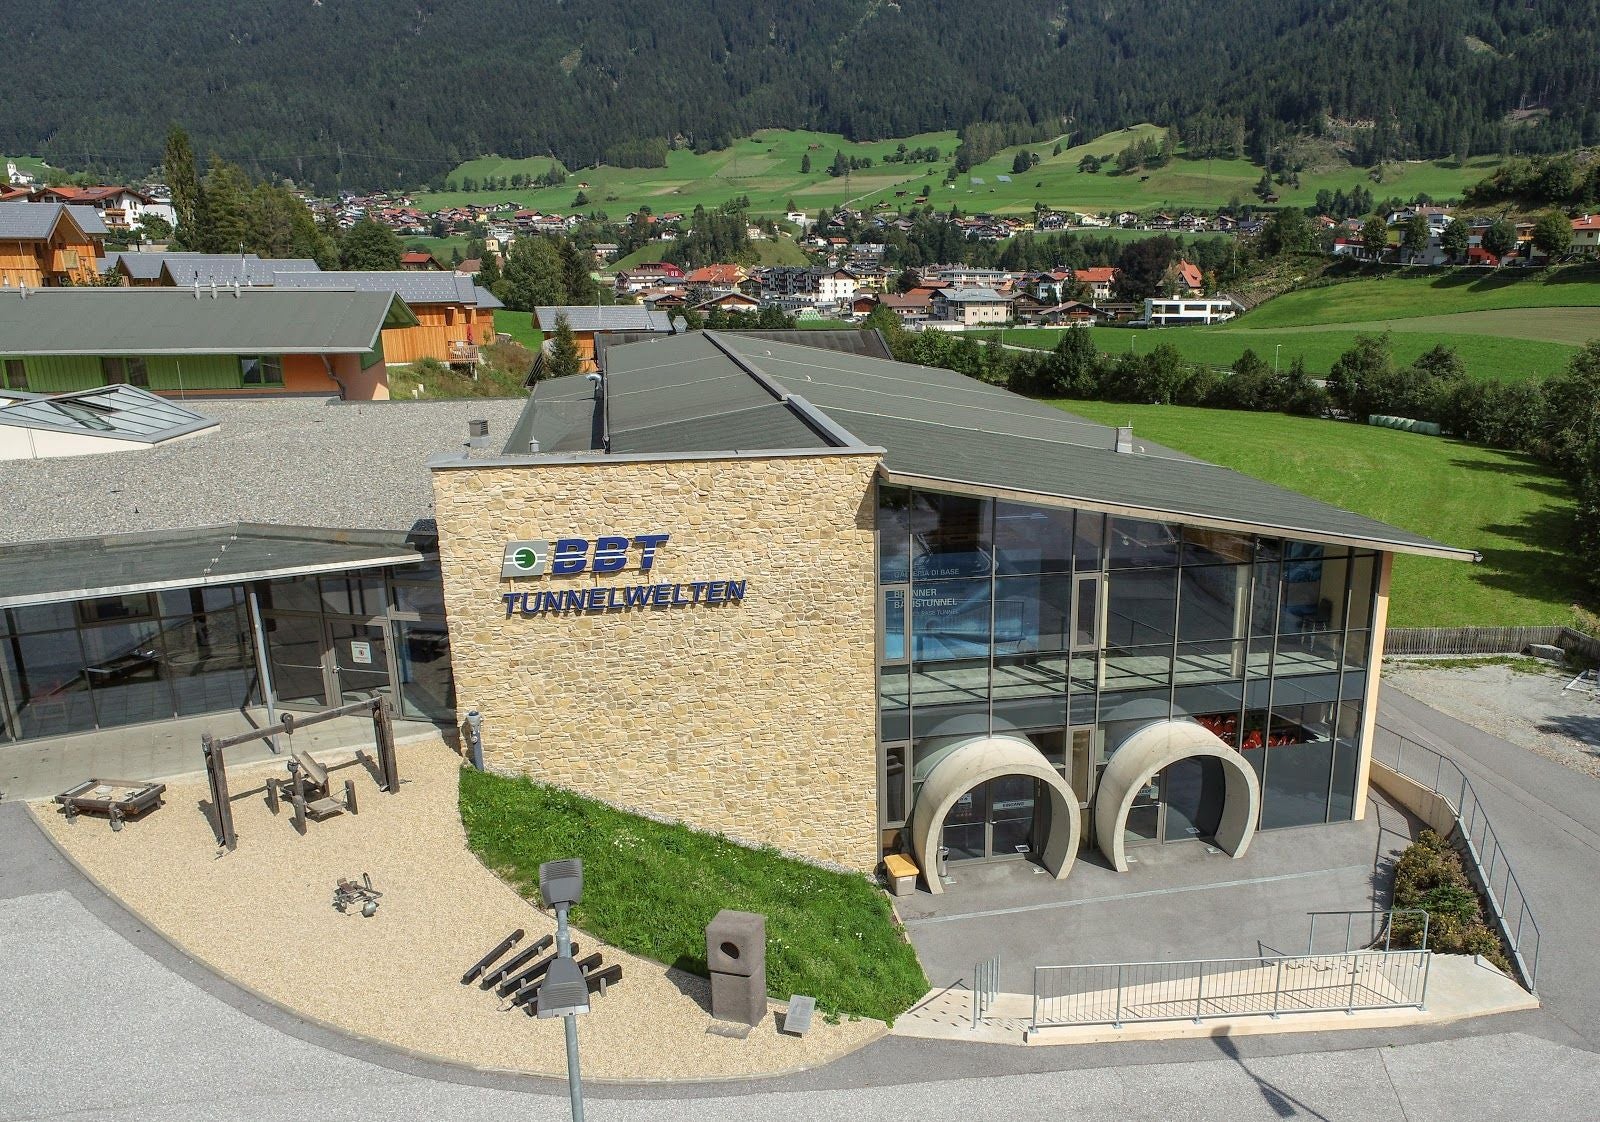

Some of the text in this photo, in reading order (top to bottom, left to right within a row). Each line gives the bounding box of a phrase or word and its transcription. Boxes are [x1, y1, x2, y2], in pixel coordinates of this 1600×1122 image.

[552, 534, 670, 575] BBT
[940, 568, 960, 576] BASE
[502, 579, 747, 615] TUNNELWELTEN
[894, 588, 937, 598] BRNNER
